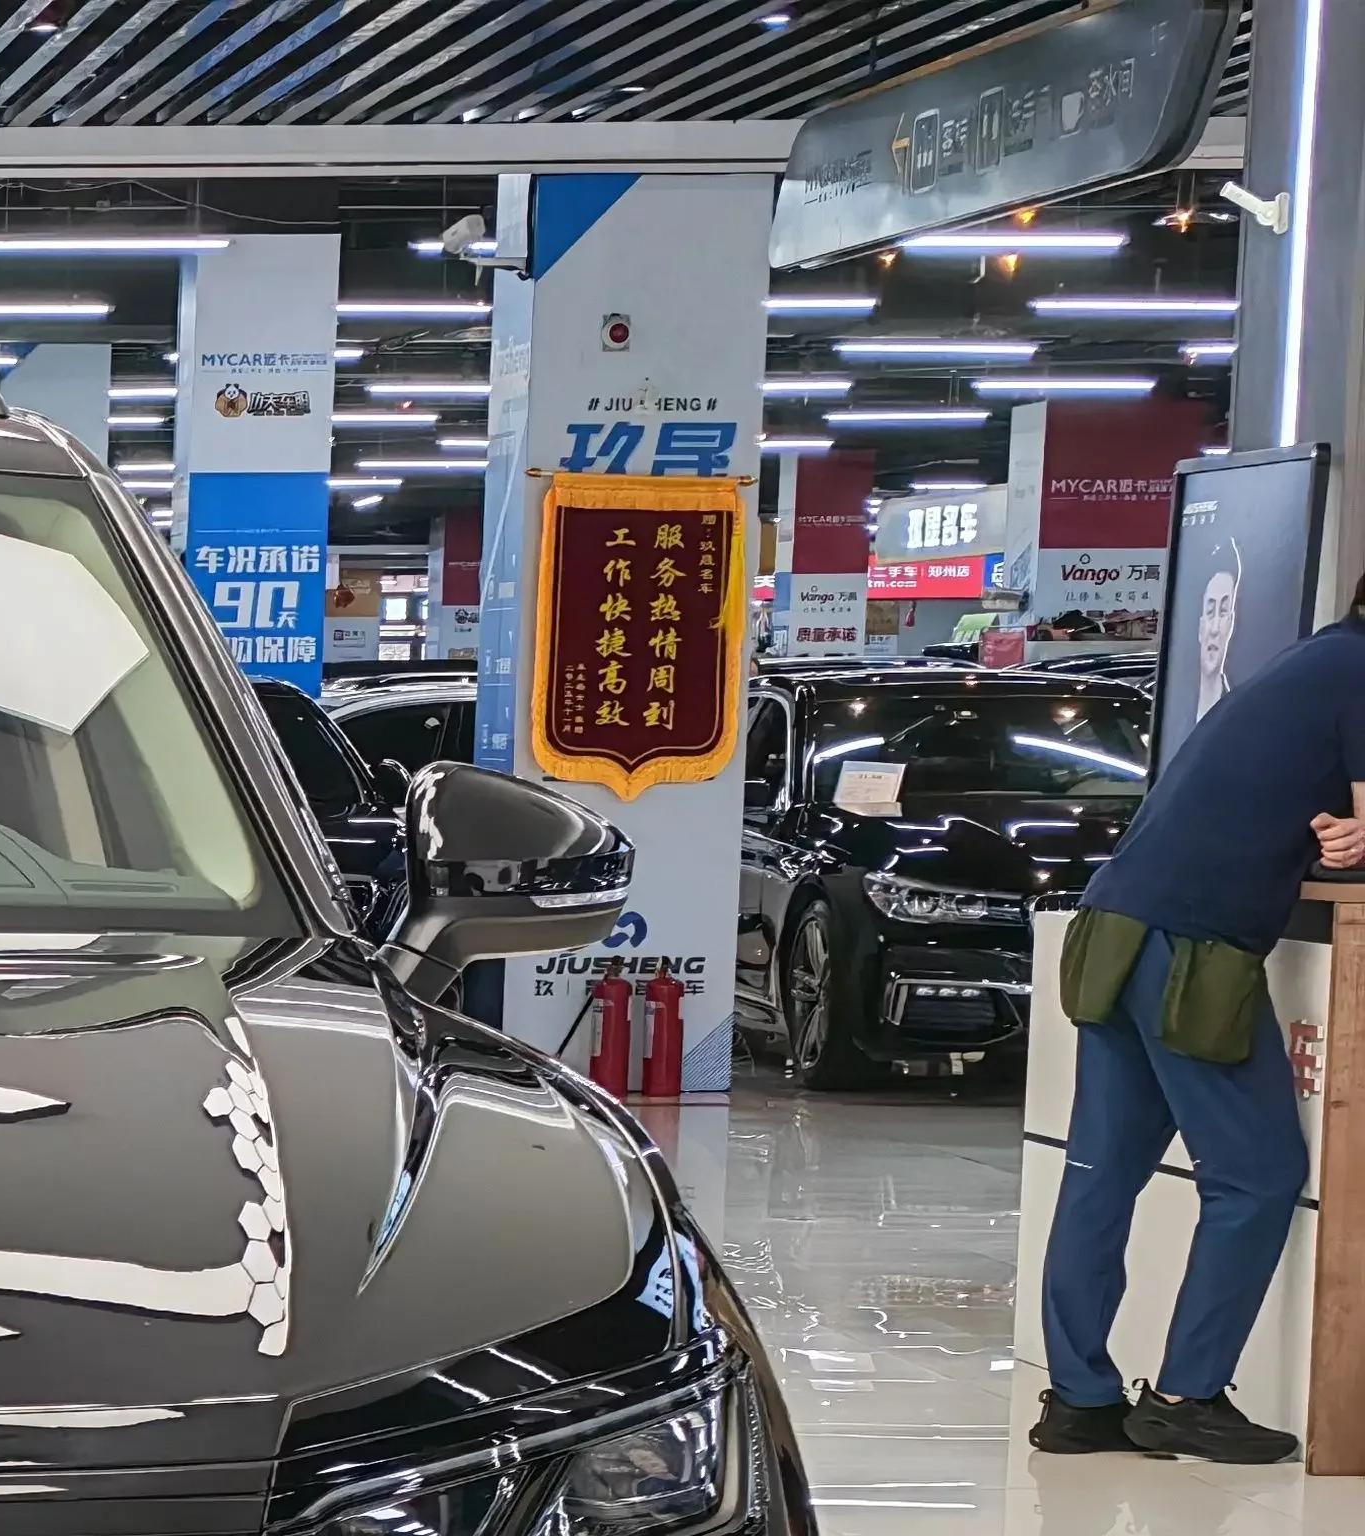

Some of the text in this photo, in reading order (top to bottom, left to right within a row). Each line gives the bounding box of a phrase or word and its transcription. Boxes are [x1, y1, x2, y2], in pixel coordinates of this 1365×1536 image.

[604, 397, 702, 412] JIU ENG
[194, 545, 320, 574] 车况承诺
[867, 565, 918, 578] 二手车
[1060, 564, 1121, 586] Vango
[594, 526, 637, 729] 工作快捷高效
[642, 523, 687, 731] 服务热情周到
